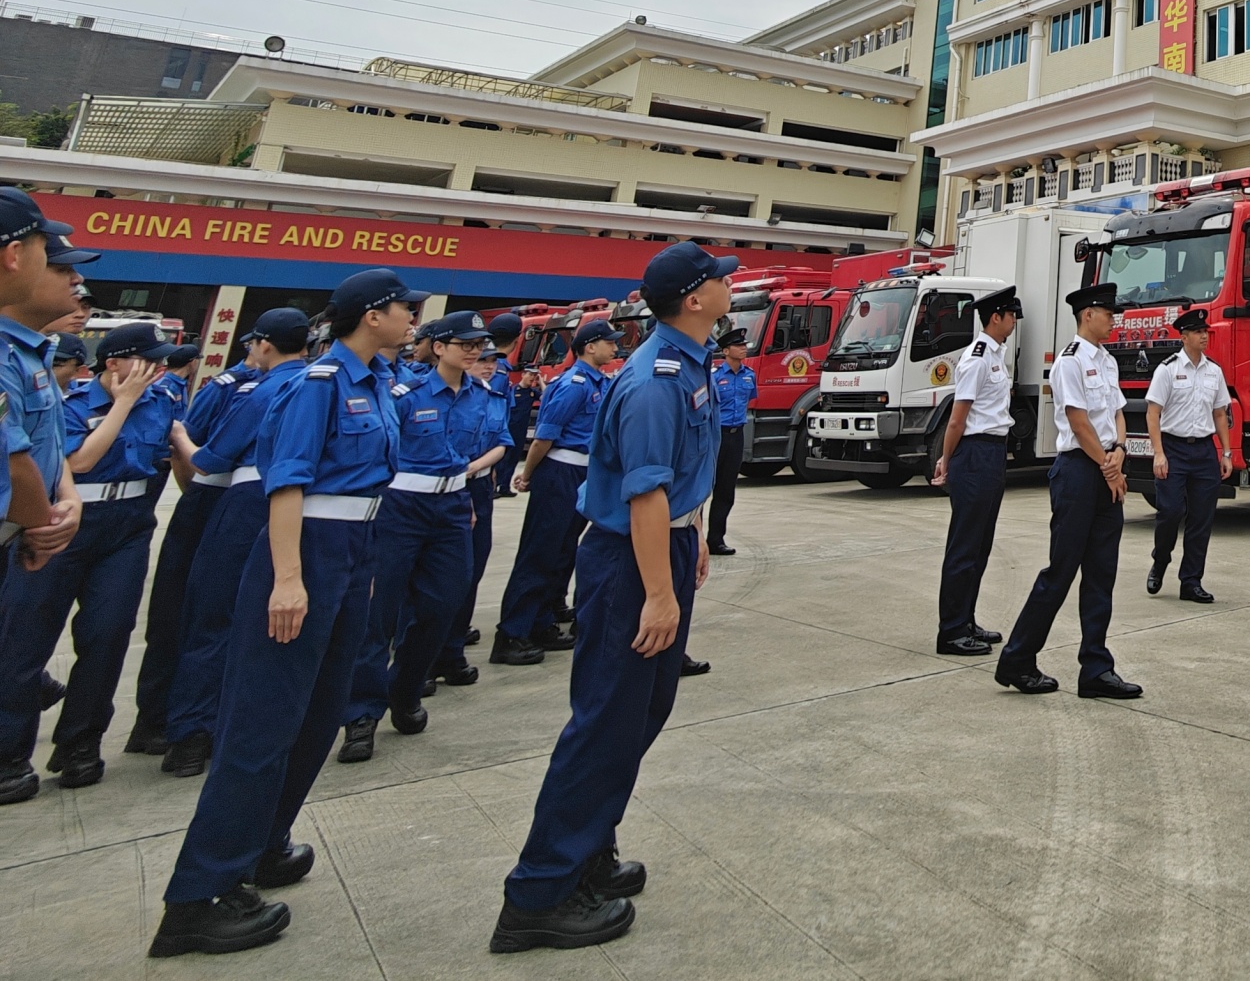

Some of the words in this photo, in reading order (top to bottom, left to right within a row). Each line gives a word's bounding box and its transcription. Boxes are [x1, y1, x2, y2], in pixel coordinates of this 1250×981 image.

[86, 211, 192, 239] CHINA
[204, 220, 272, 245] FIRE
[279, 225, 344, 249] AND
[352, 231, 460, 258] RESCUE
[1124, 316, 1162, 329] RESCUE
